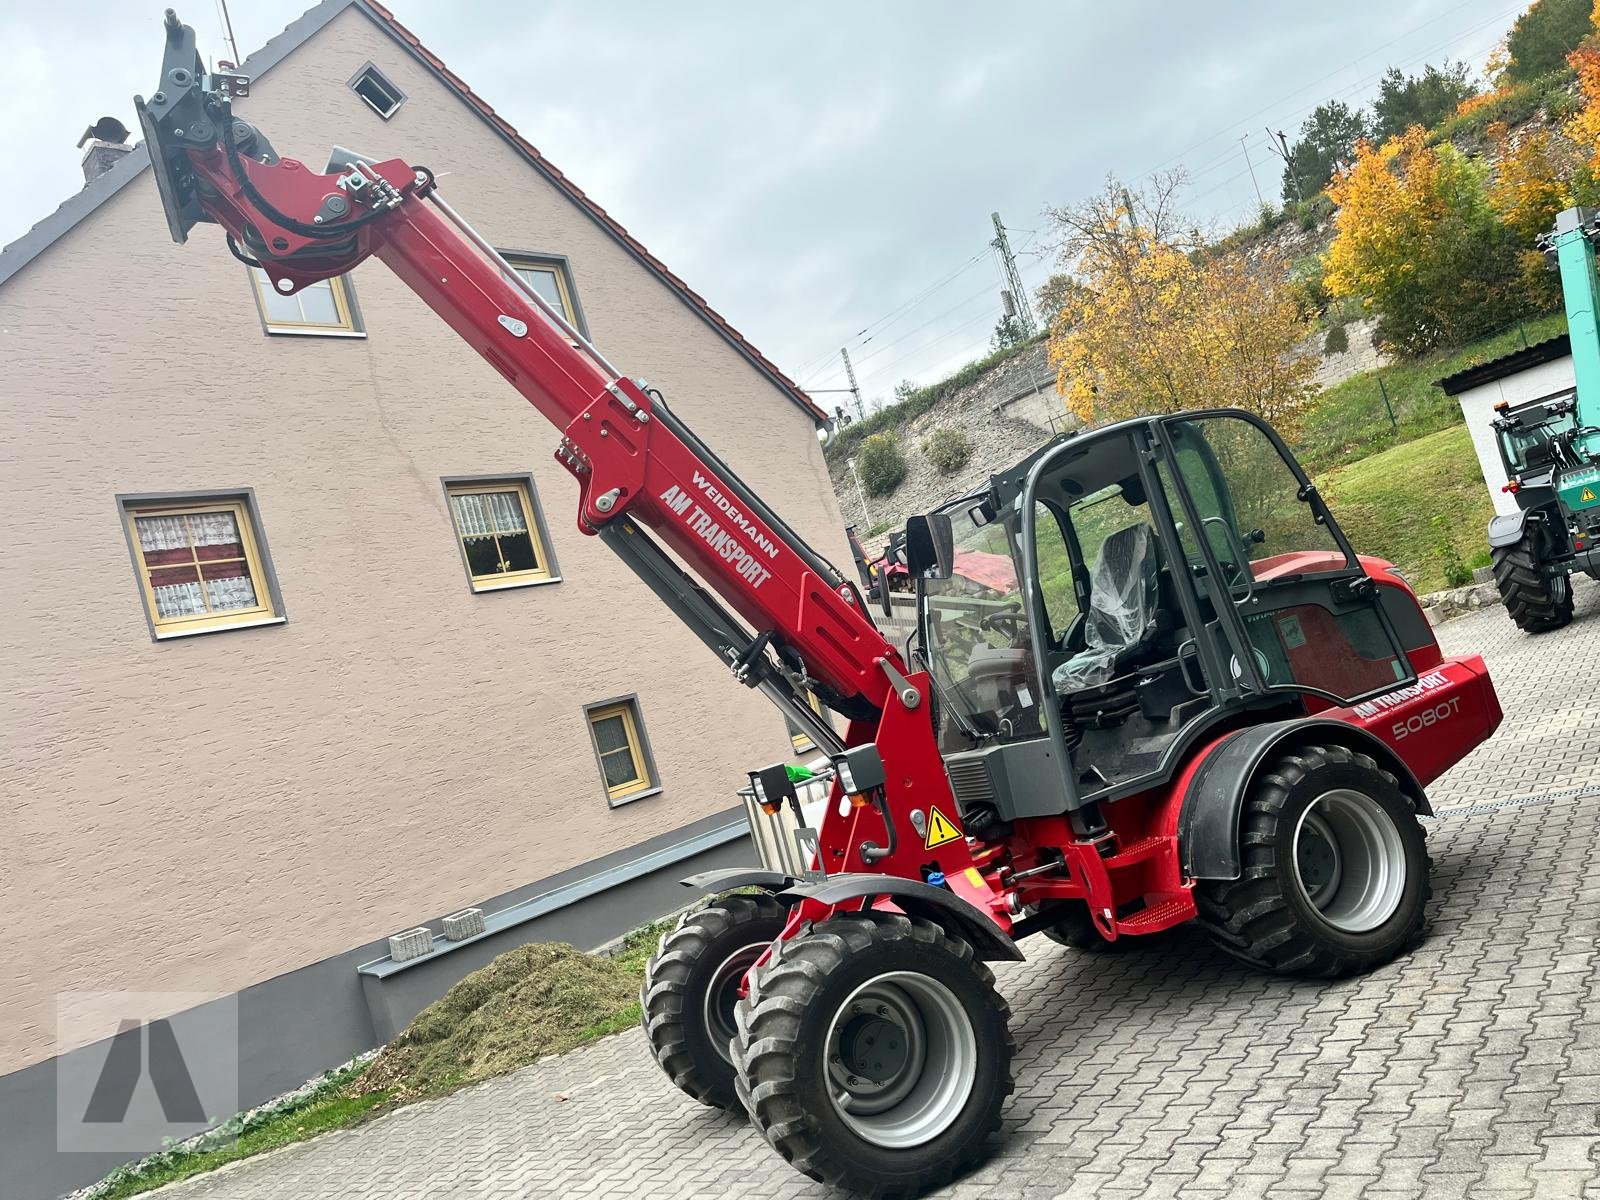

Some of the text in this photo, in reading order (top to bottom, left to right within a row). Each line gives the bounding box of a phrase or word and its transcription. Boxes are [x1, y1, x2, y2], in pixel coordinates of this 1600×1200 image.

[659, 484, 772, 589] AM TRANSPORT
[692, 470, 780, 559] WEIDEMANN
[1352, 701, 1380, 719] AM
[1374, 671, 1449, 708] TRANSPORT
[1391, 696, 1460, 741] 5080T
